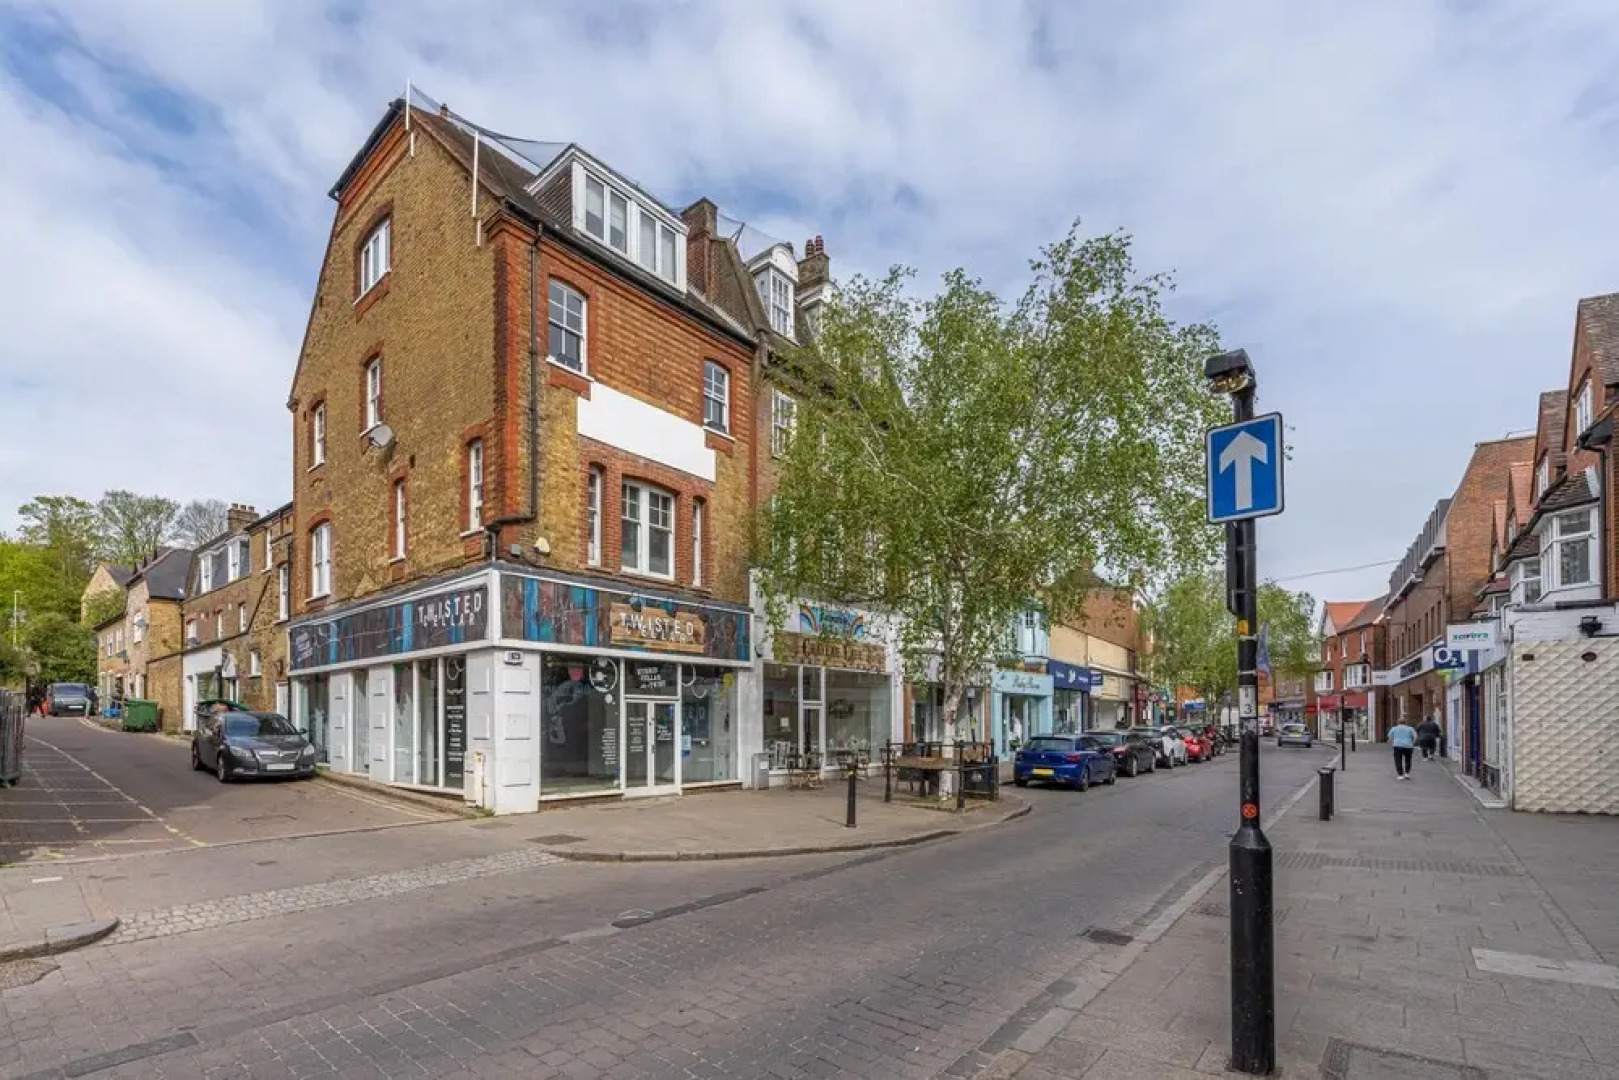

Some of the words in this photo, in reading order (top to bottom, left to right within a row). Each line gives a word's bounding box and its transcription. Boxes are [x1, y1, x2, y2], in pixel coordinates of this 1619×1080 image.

[418, 593, 481, 622] TWISTED
[620, 612, 693, 635] TWISTED
[626, 624, 686, 644] CELLAR
